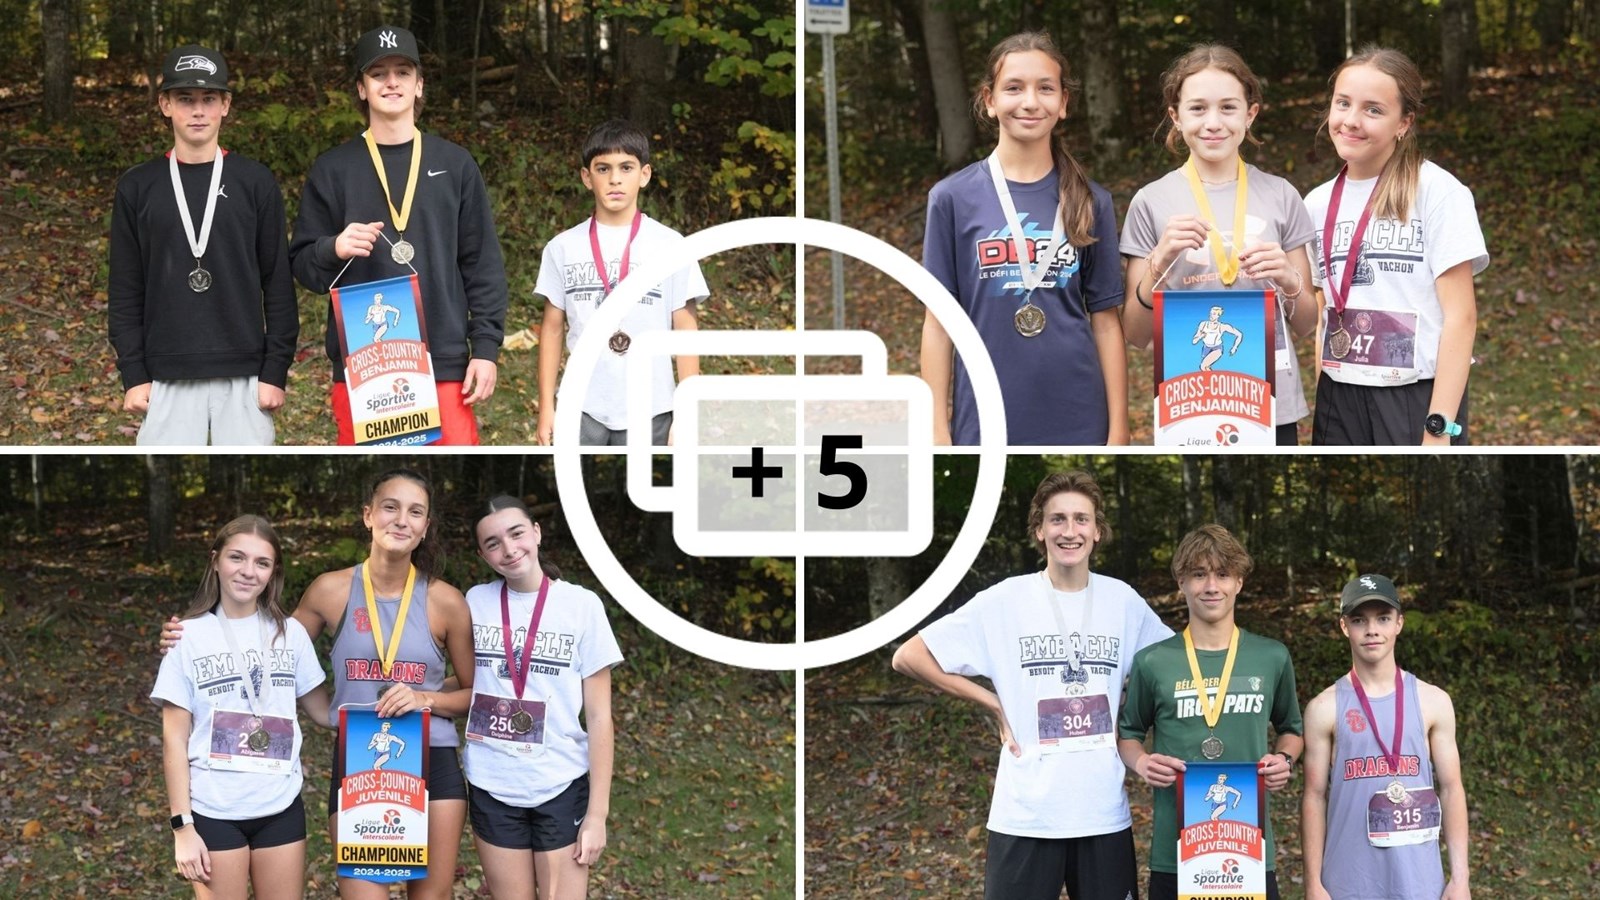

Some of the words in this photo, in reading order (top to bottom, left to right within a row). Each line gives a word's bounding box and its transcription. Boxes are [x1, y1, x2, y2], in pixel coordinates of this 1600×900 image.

[379, 30, 398, 48] NY
[979, 271, 988, 279] LE
[990, 269, 1008, 278] DÉFI
[1378, 261, 1415, 274] VACHON
[351, 342, 423, 374] CROSS-COUNTRY
[360, 360, 418, 380] BENJAMIN
[373, 392, 391, 402] Ligue
[1165, 374, 1265, 407] CROSS-COUNTRY
[366, 392, 416, 411] Sportive
[376, 402, 416, 414] interscolaire
[1170, 399, 1261, 419] BENJAMINE
[365, 412, 429, 439] CHAMPION
[345, 659, 427, 685] DRAONS
[530, 664, 560, 676] VACHON
[208, 683, 235, 697] BENOIT
[1175, 677, 1220, 691] BÉLAGER
[1223, 694, 1265, 714] PATS
[1062, 714, 1092, 731] 304
[346, 772, 421, 796] CROSS-COUNTRY
[355, 788, 411, 806] JUVÉNILE
[1393, 808, 1422, 825] 315
[353, 823, 406, 836] Sportive
[1185, 823, 1258, 846] CROSS-COUNTRY
[341, 846, 424, 863] CHAMPIONNE
[1194, 838, 1249, 854] JUVÉNILE
[353, 867, 411, 877] 2024-2025
[1193, 873, 1244, 886] Sportive
[1201, 868, 1219, 876] Ligue
